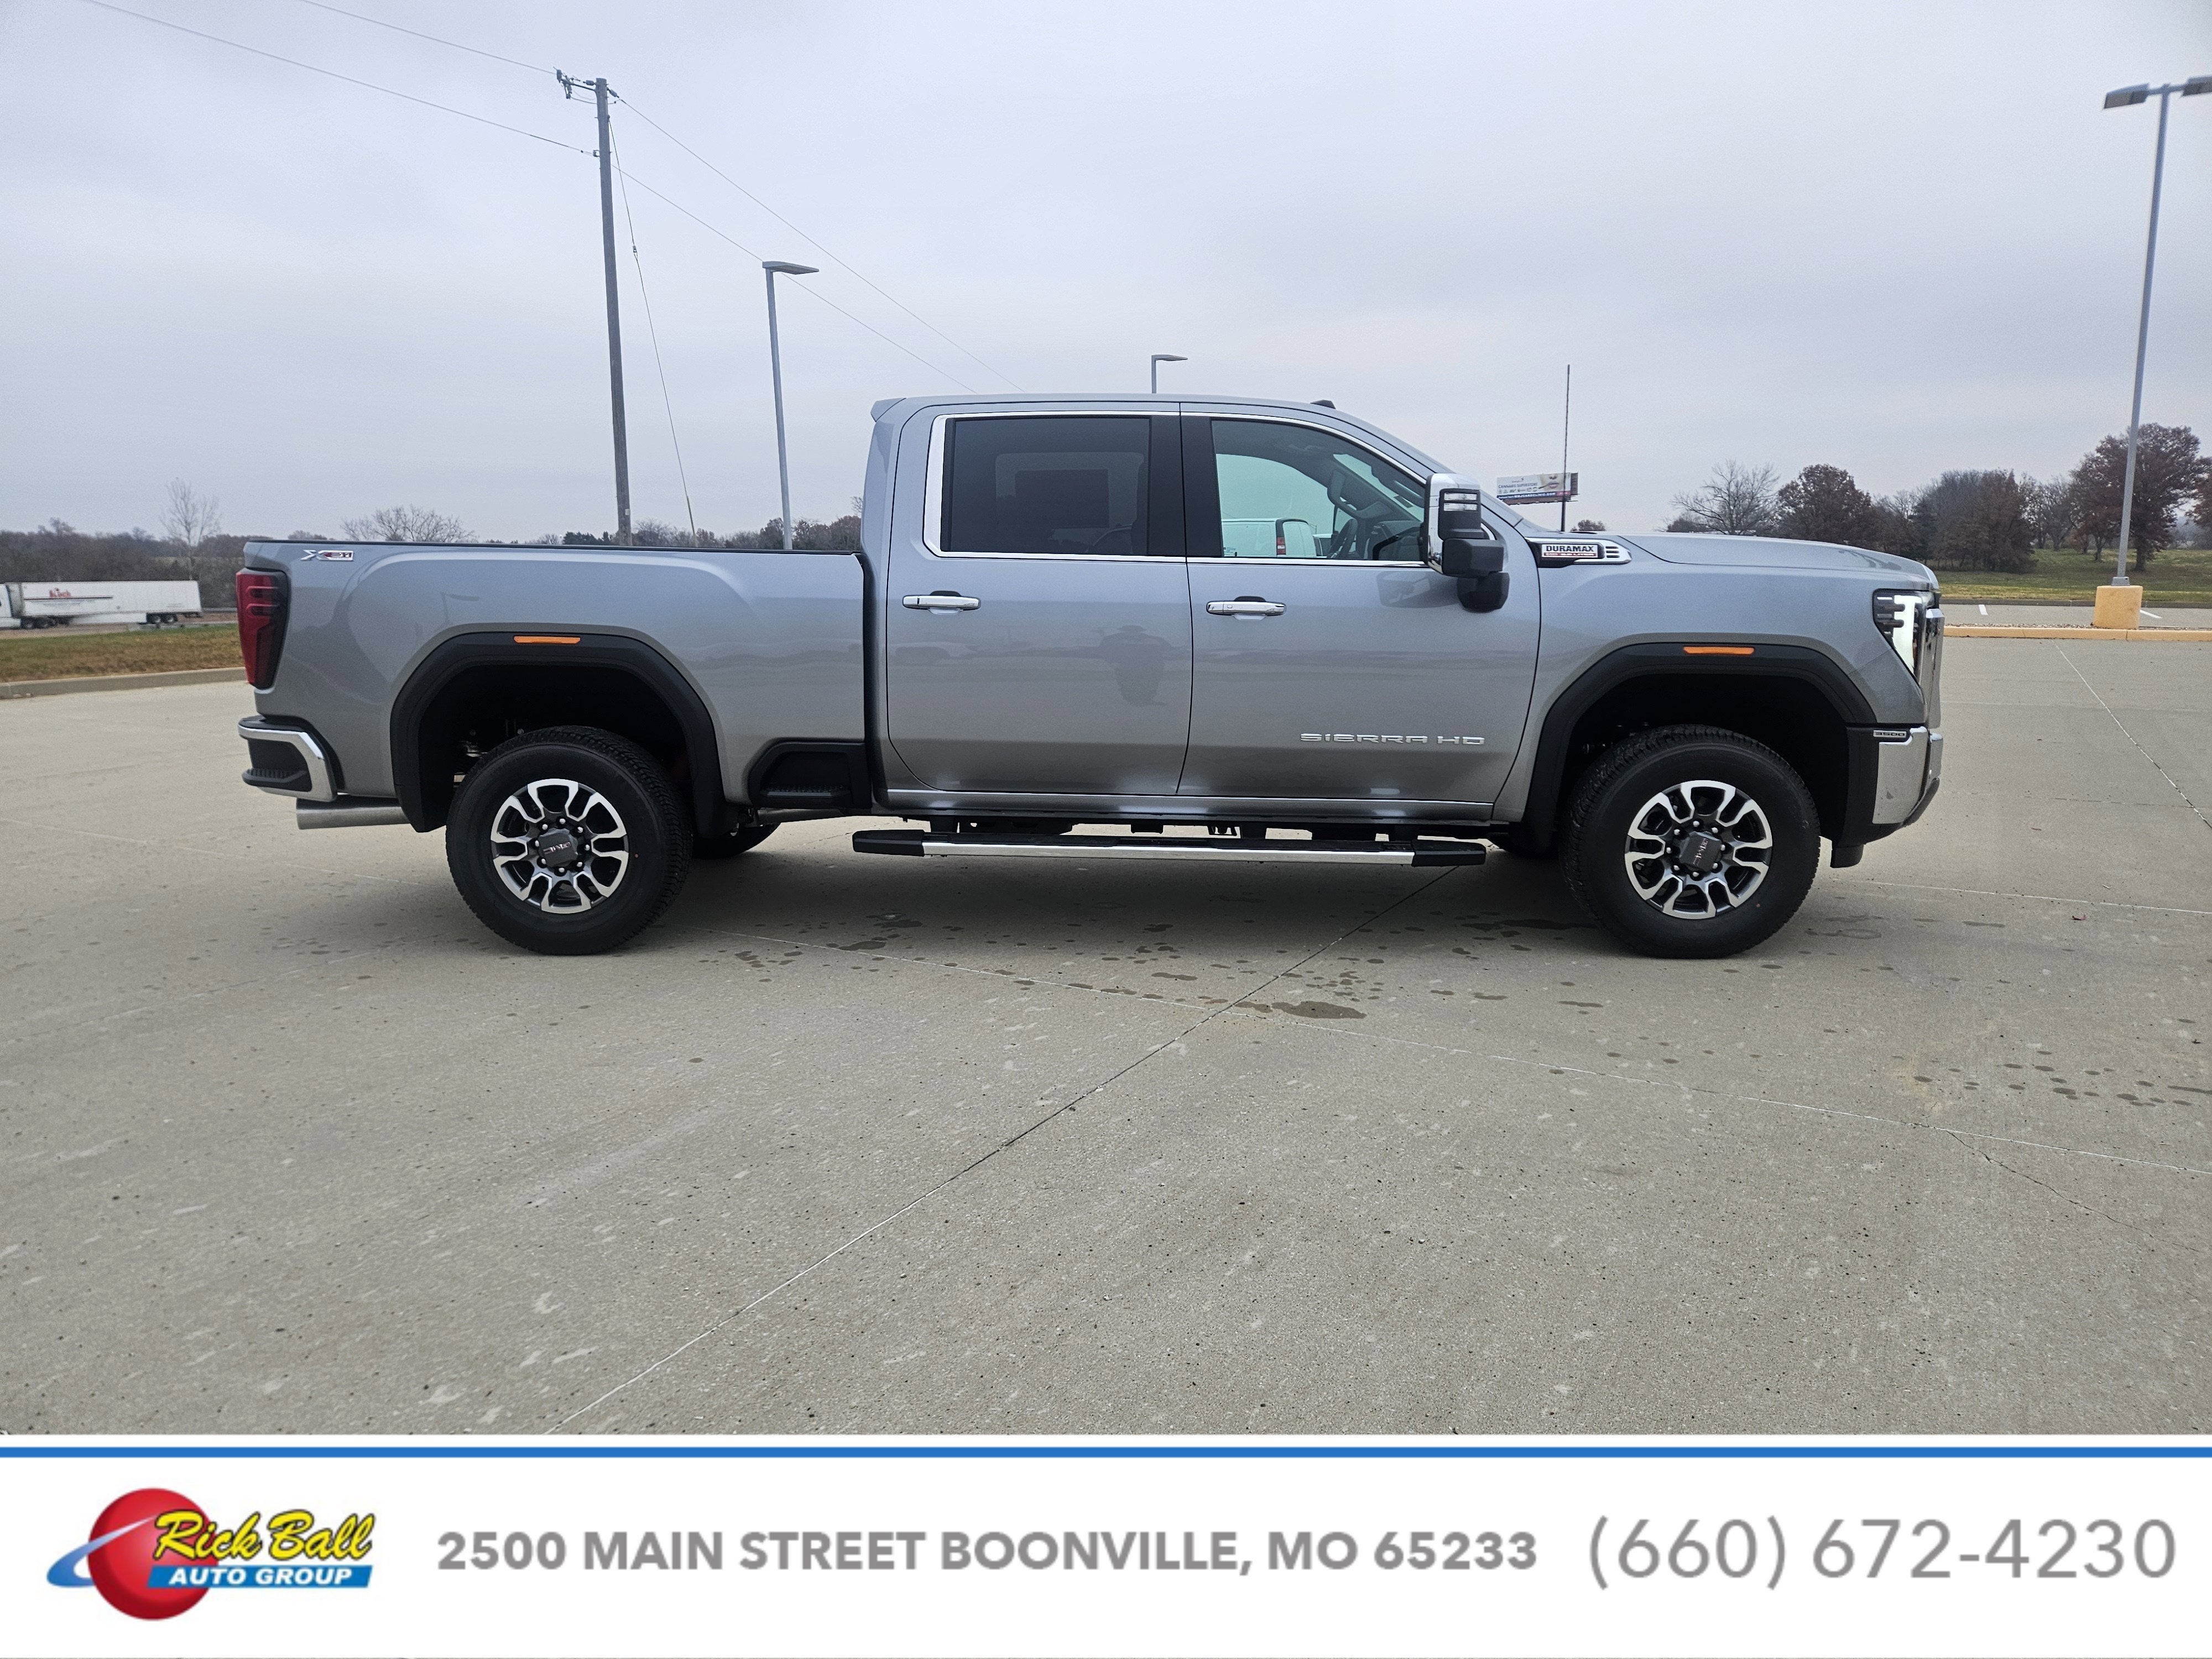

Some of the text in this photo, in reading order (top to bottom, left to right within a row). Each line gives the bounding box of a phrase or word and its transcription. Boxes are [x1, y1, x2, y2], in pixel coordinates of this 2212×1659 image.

[1300, 733, 1485, 744] SIERRA HD
[1693, 838, 1709, 866] GMC
